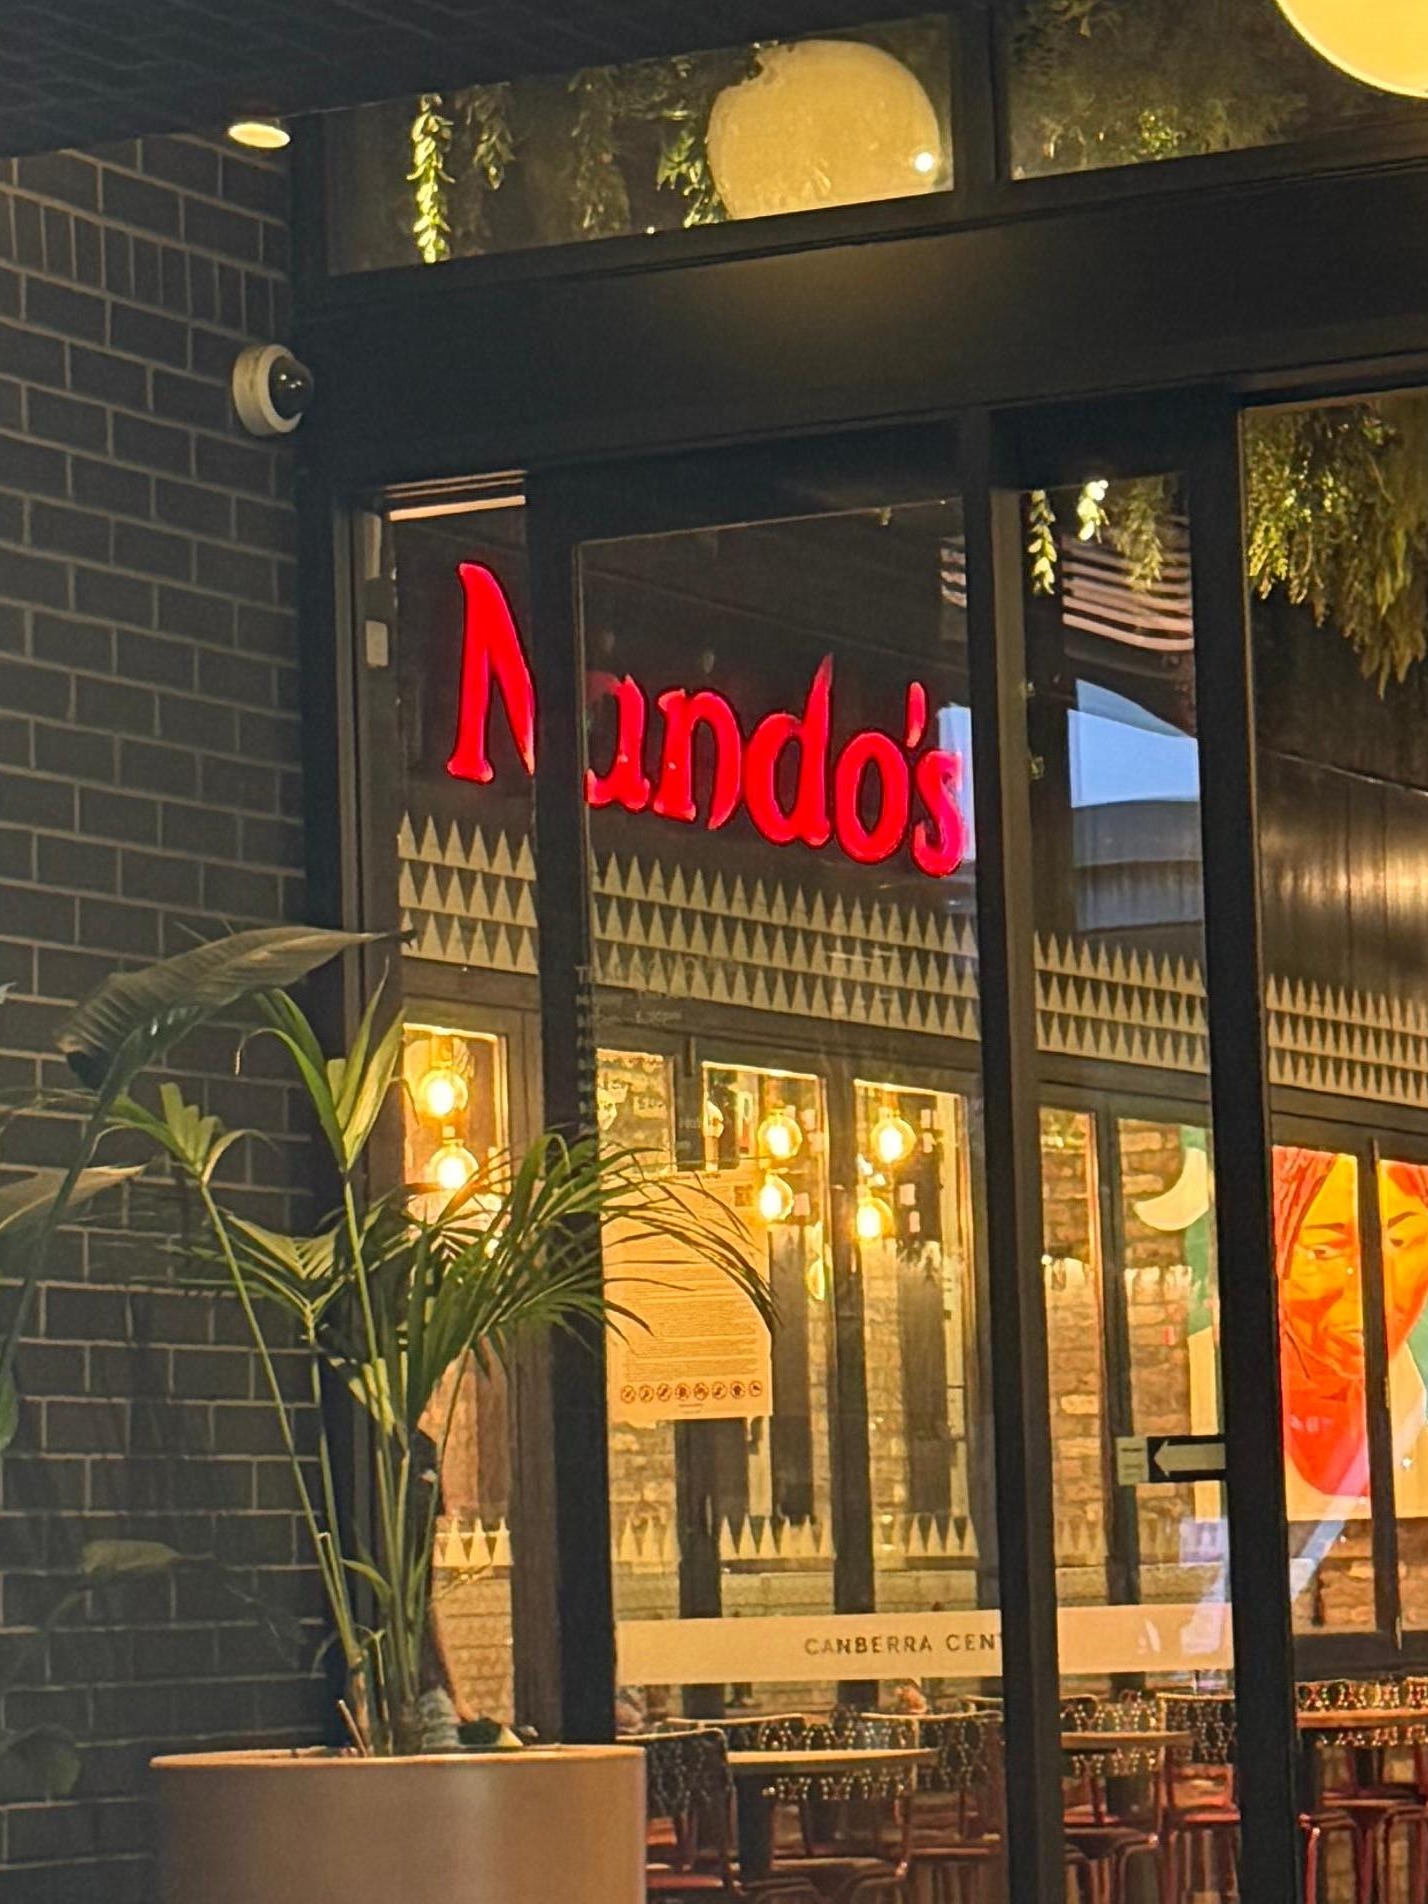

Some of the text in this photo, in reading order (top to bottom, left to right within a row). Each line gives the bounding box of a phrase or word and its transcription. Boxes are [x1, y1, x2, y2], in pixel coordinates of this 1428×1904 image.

[444, 560, 966, 879] Nando's
[804, 1632, 1002, 1656] CANBERRA CEN
